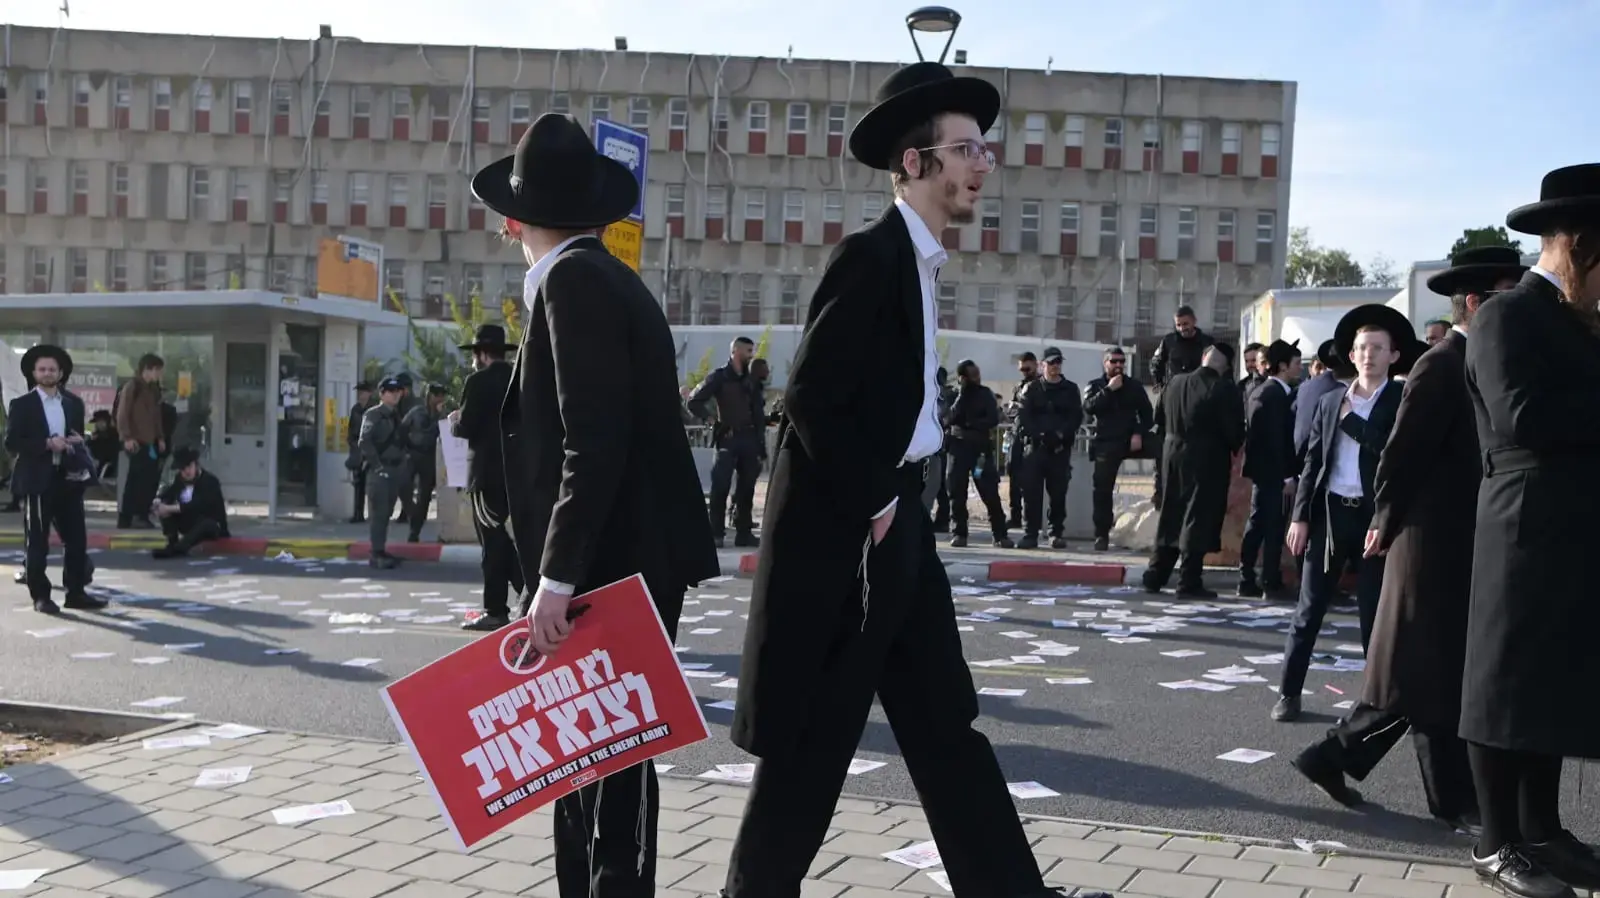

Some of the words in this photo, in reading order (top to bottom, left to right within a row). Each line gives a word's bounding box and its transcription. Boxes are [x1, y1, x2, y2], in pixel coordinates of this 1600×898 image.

[467, 665, 582, 740] מתגייסים
[575, 648, 616, 689] לא
[545, 671, 659, 757] לצבא
[461, 717, 555, 799] אויב
[486, 799, 505, 816] WE
[502, 787, 529, 805] WILL
[526, 776, 547, 794] NOT
[546, 760, 579, 784] ENLIST
[578, 755, 591, 769] IN
[589, 747, 610, 763] THE
[608, 734, 642, 755] ENEMY
[640, 724, 669, 743] ARMY
